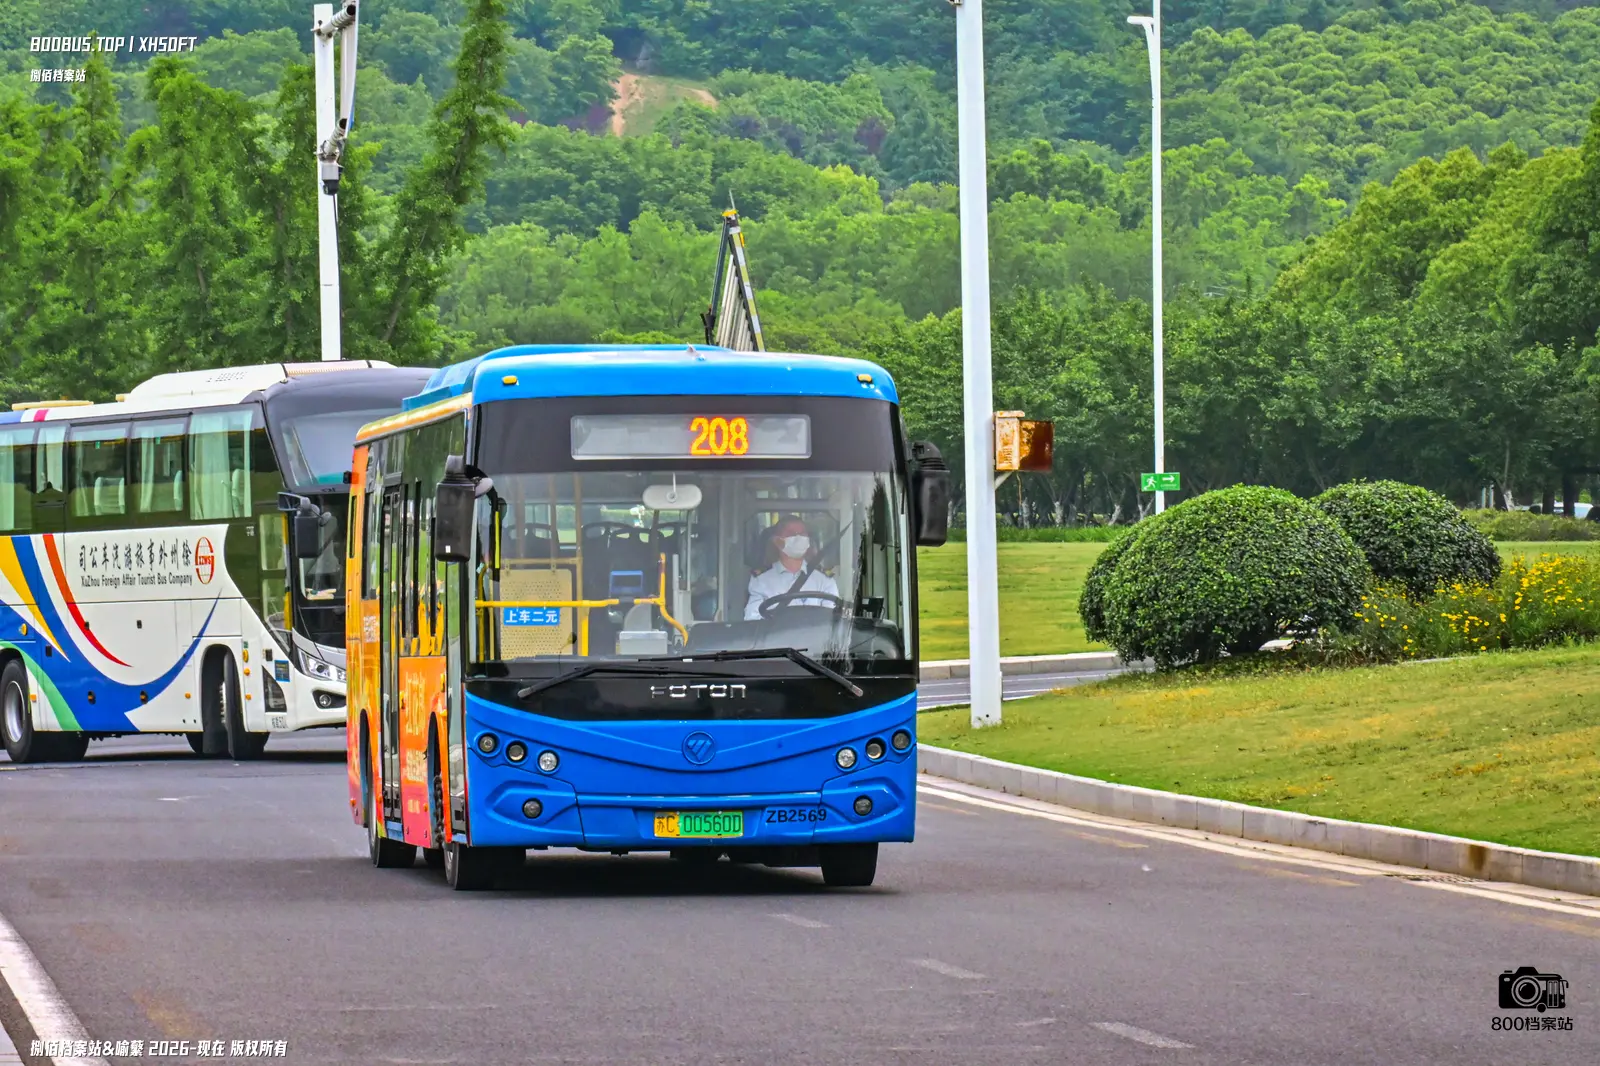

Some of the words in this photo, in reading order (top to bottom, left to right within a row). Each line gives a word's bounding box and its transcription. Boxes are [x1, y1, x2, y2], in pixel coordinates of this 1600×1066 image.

[689, 416, 749, 456] 208
[81, 575, 100, 588] XuZhou
[101, 574, 121, 589] Foreign
[122, 573, 136, 586] Affair
[138, 573, 156, 585] Tourist
[157, 573, 167, 584] Bus
[168, 572, 192, 587] Company
[505, 608, 558, 624] 上车二元
[650, 684, 747, 699] FOTON
[765, 808, 827, 824] ZB2569
